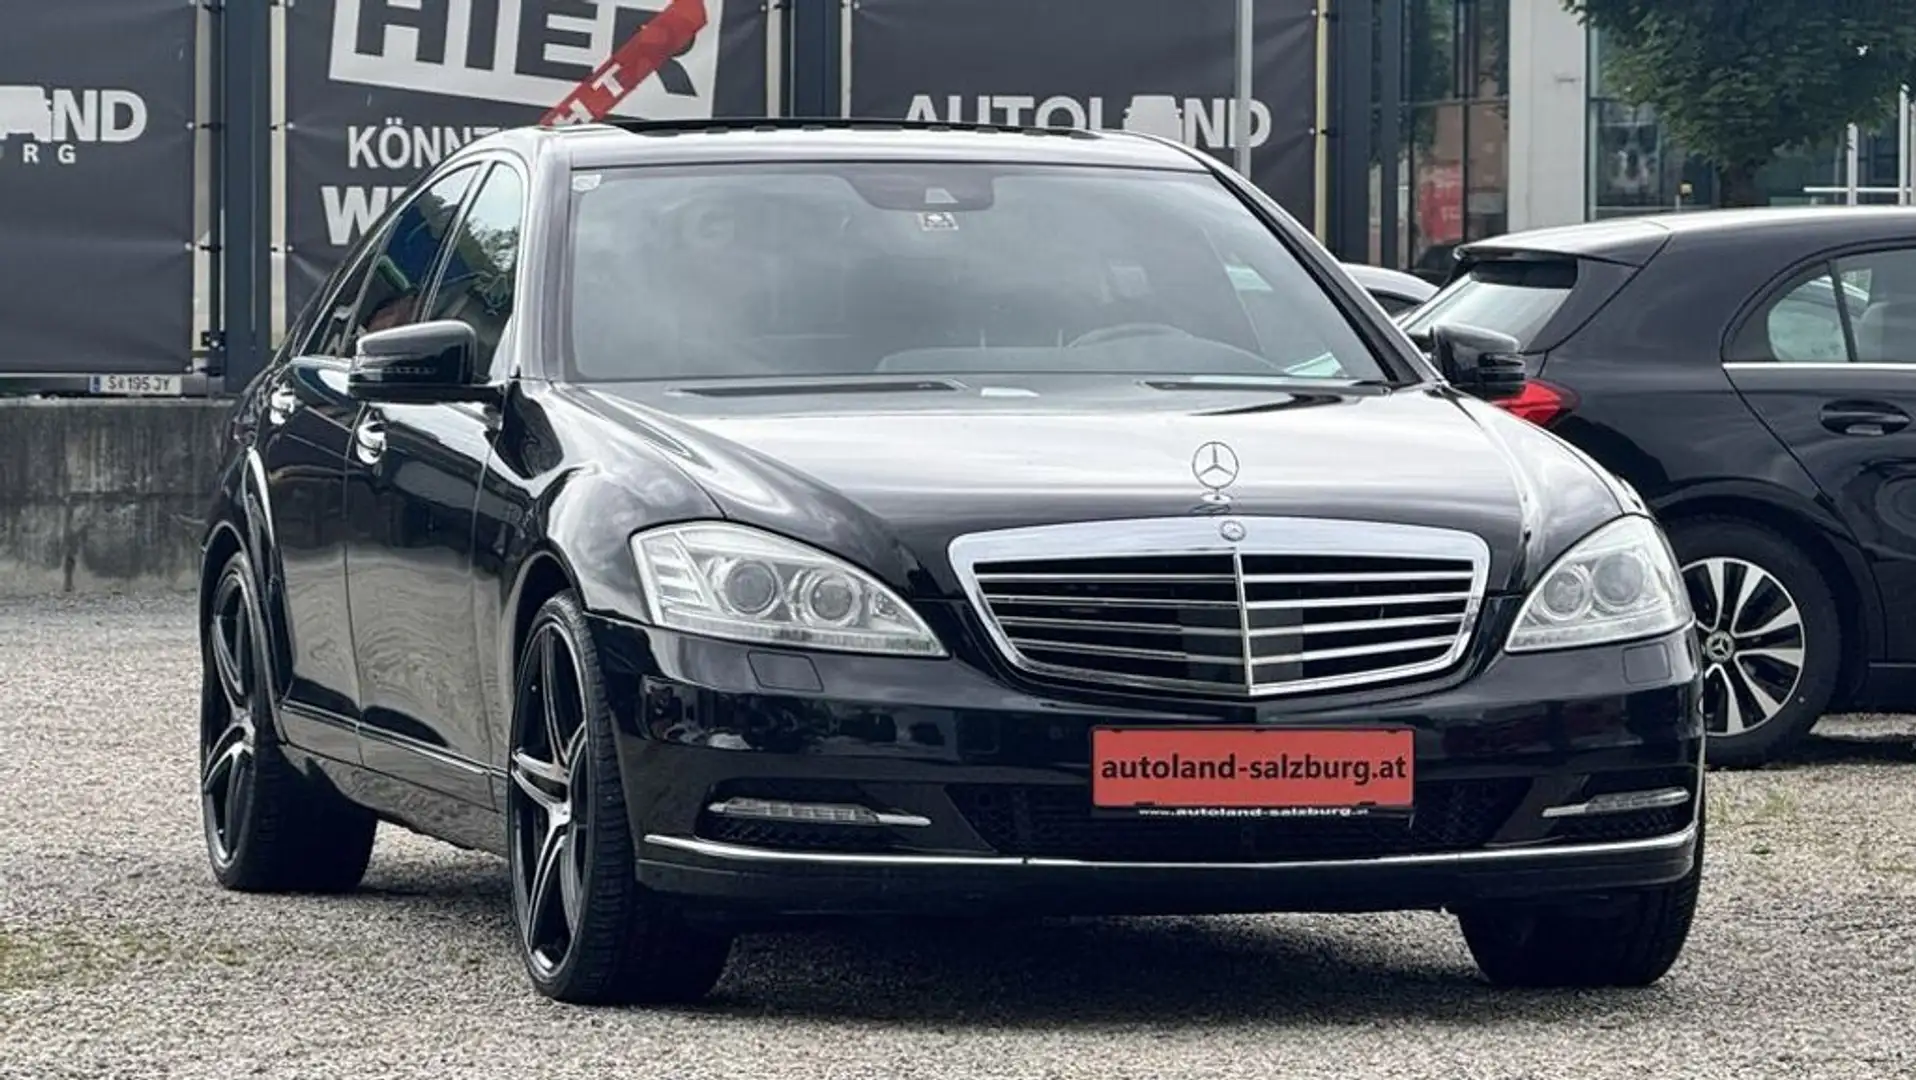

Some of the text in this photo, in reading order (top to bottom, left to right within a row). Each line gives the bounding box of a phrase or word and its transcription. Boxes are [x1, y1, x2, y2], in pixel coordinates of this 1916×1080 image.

[347, 117, 500, 169] KÖNN
[904, 95, 1272, 148] AUTOLND
[1101, 753, 1406, 785] autoland-salzburg.at
